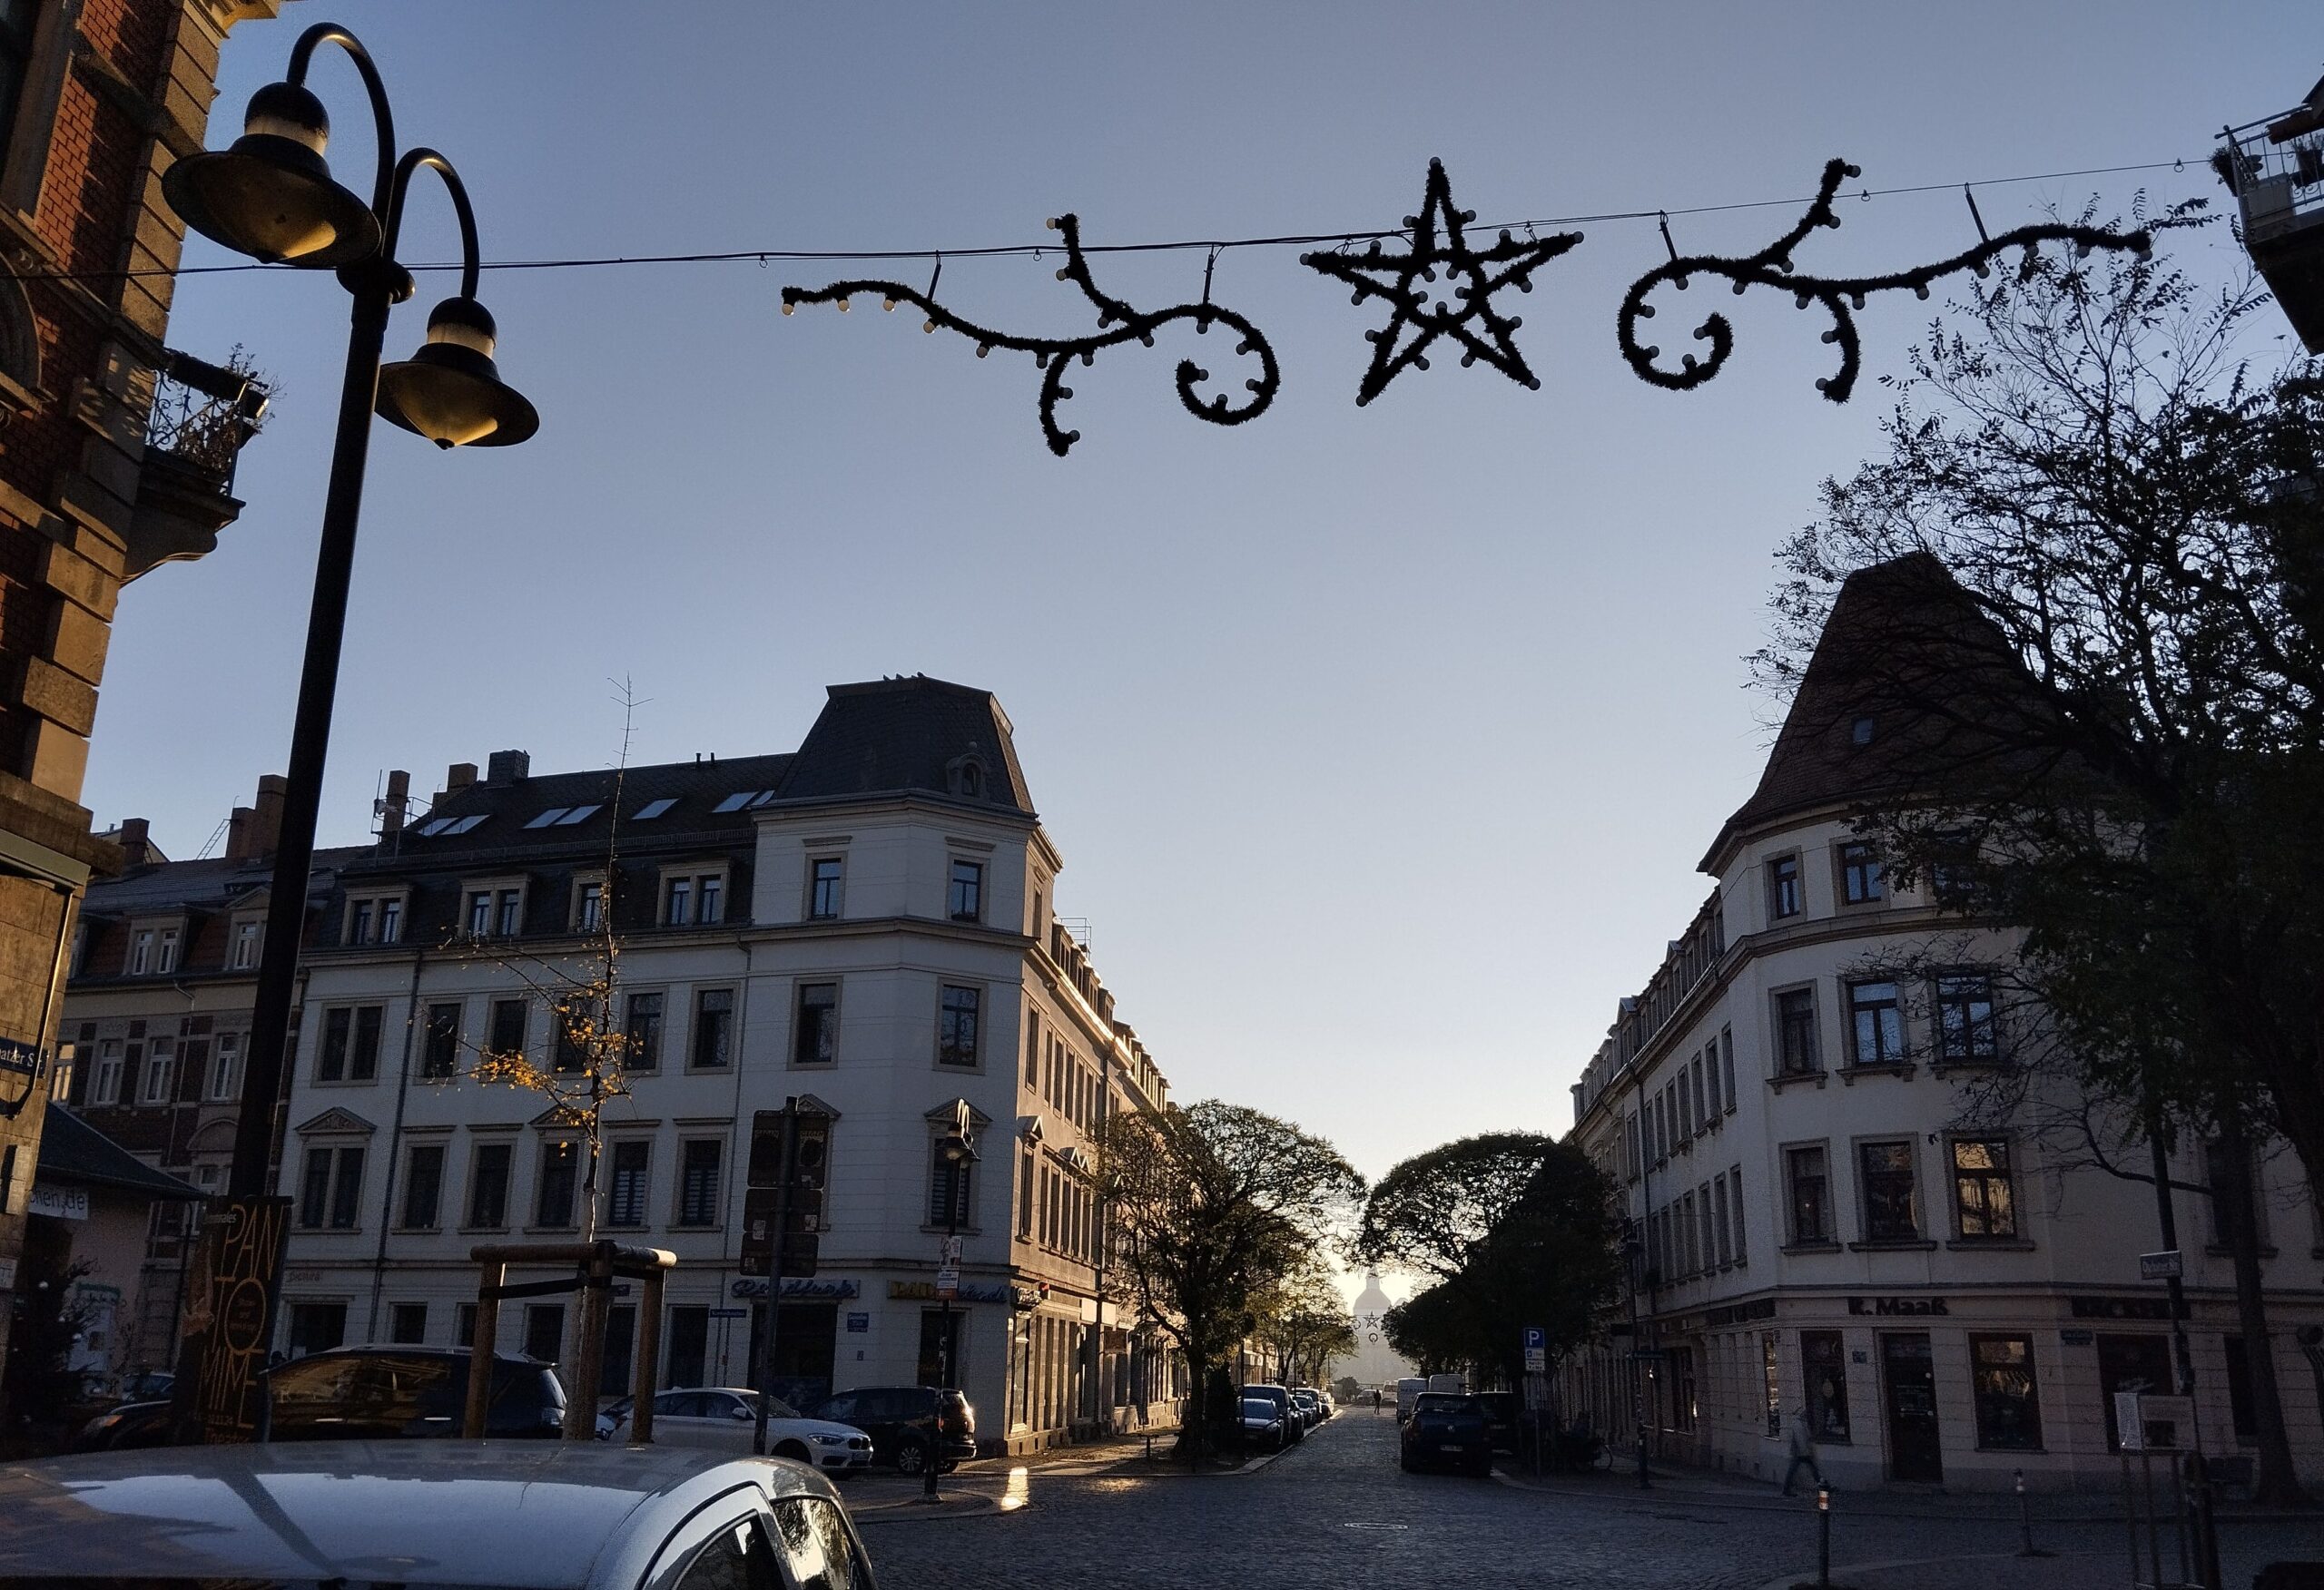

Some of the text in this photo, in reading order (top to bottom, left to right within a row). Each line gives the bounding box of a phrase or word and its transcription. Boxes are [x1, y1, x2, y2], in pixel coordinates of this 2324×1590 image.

[0, 1047, 25, 1065] atzer
[1876, 1295, 1949, 1316] Maaß
[1529, 1330, 1540, 1346] P
